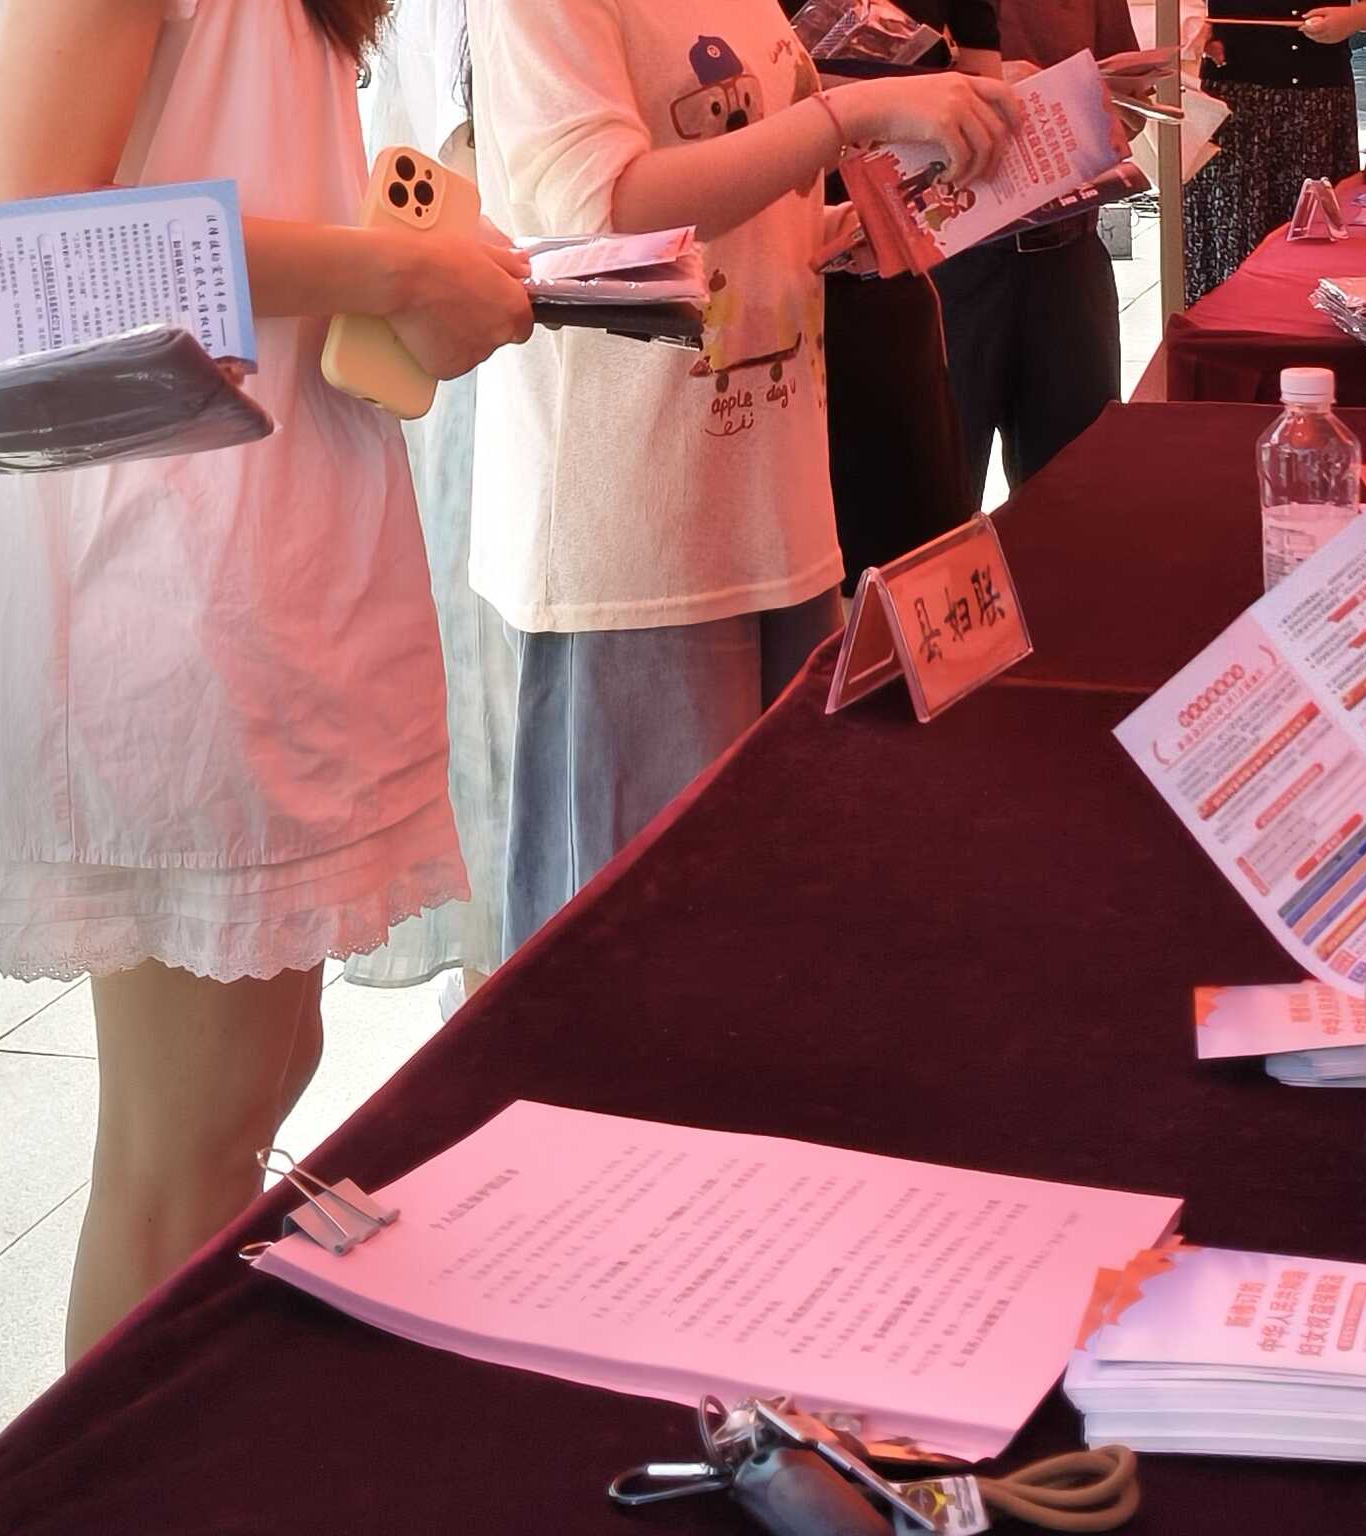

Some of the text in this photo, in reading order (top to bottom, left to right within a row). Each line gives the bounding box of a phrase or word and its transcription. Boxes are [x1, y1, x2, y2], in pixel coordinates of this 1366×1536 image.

[1256, 1268, 1312, 1355] 中华人民共和国
[1293, 1271, 1348, 1359] 妇女权益保障法
